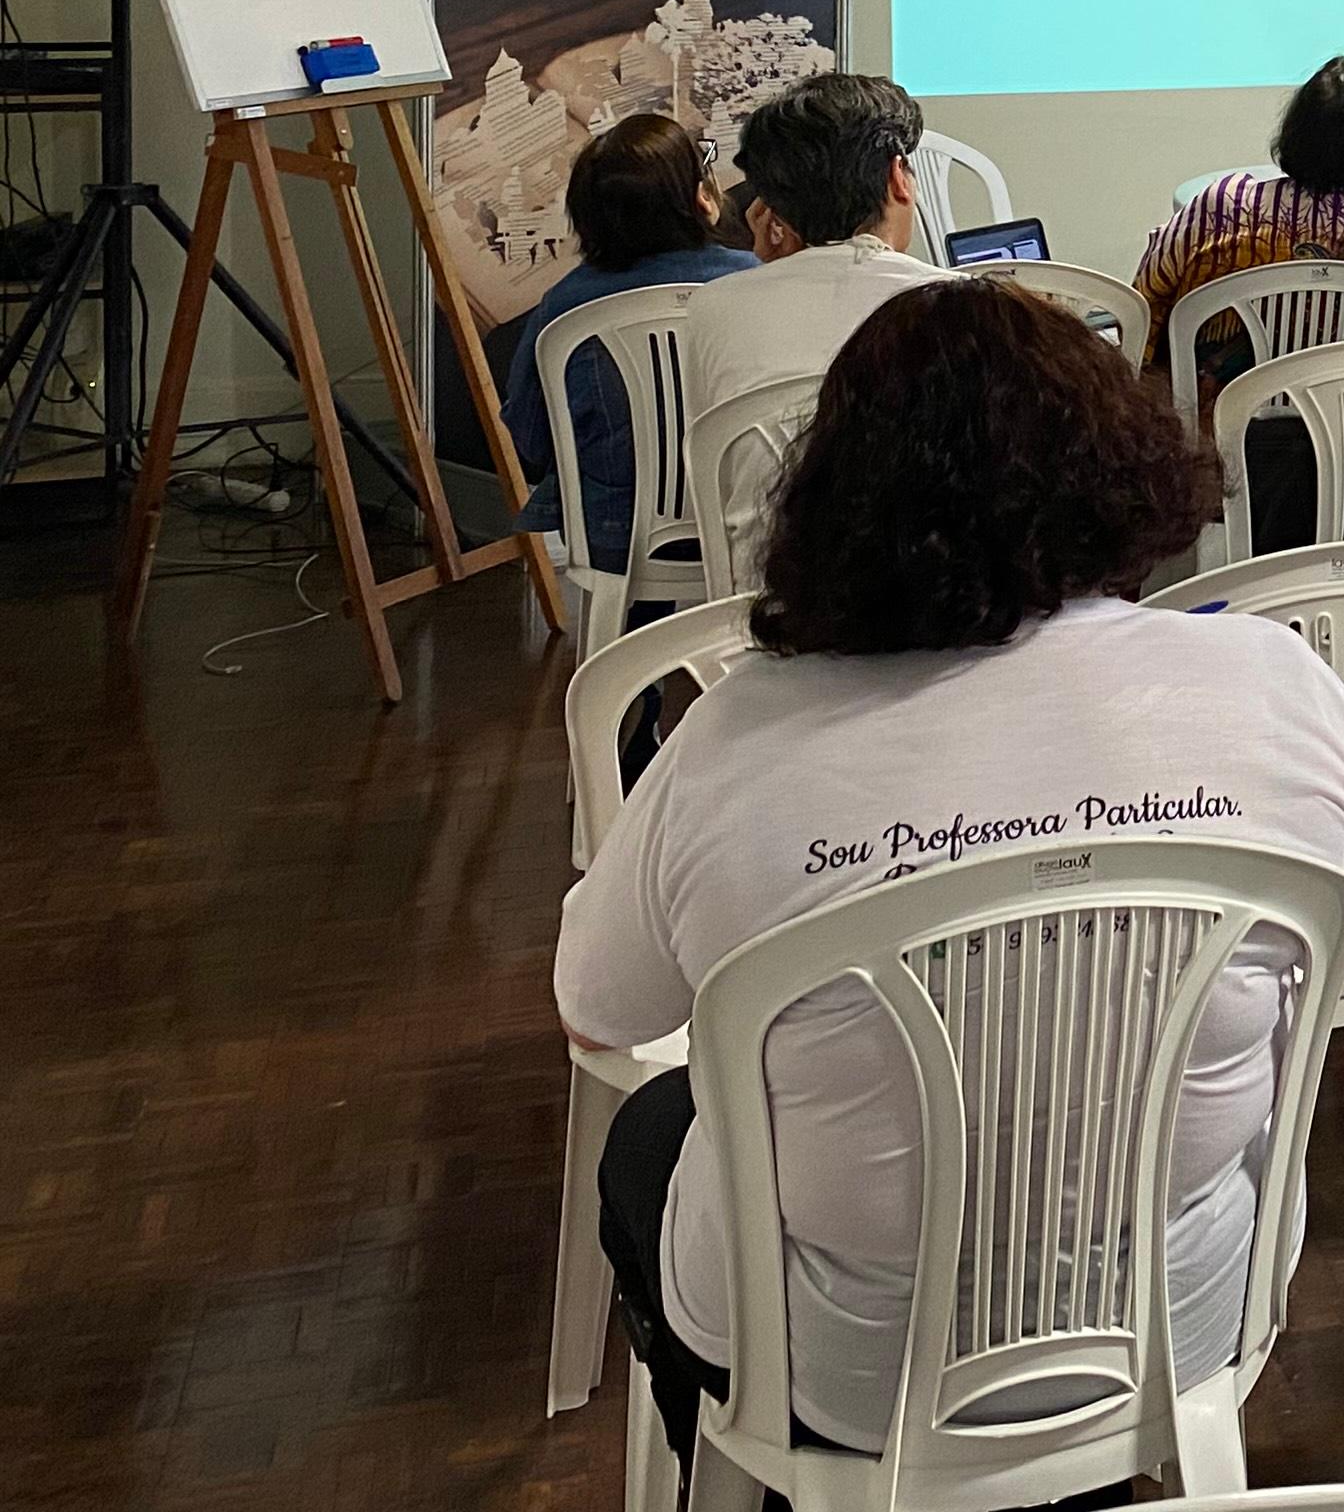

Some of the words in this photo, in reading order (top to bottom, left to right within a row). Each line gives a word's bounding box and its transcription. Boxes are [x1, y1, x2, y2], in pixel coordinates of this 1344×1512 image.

[805, 838, 874, 875] Sou
[882, 811, 1068, 861] Professora
[1075, 786, 1242, 829] Particular.
